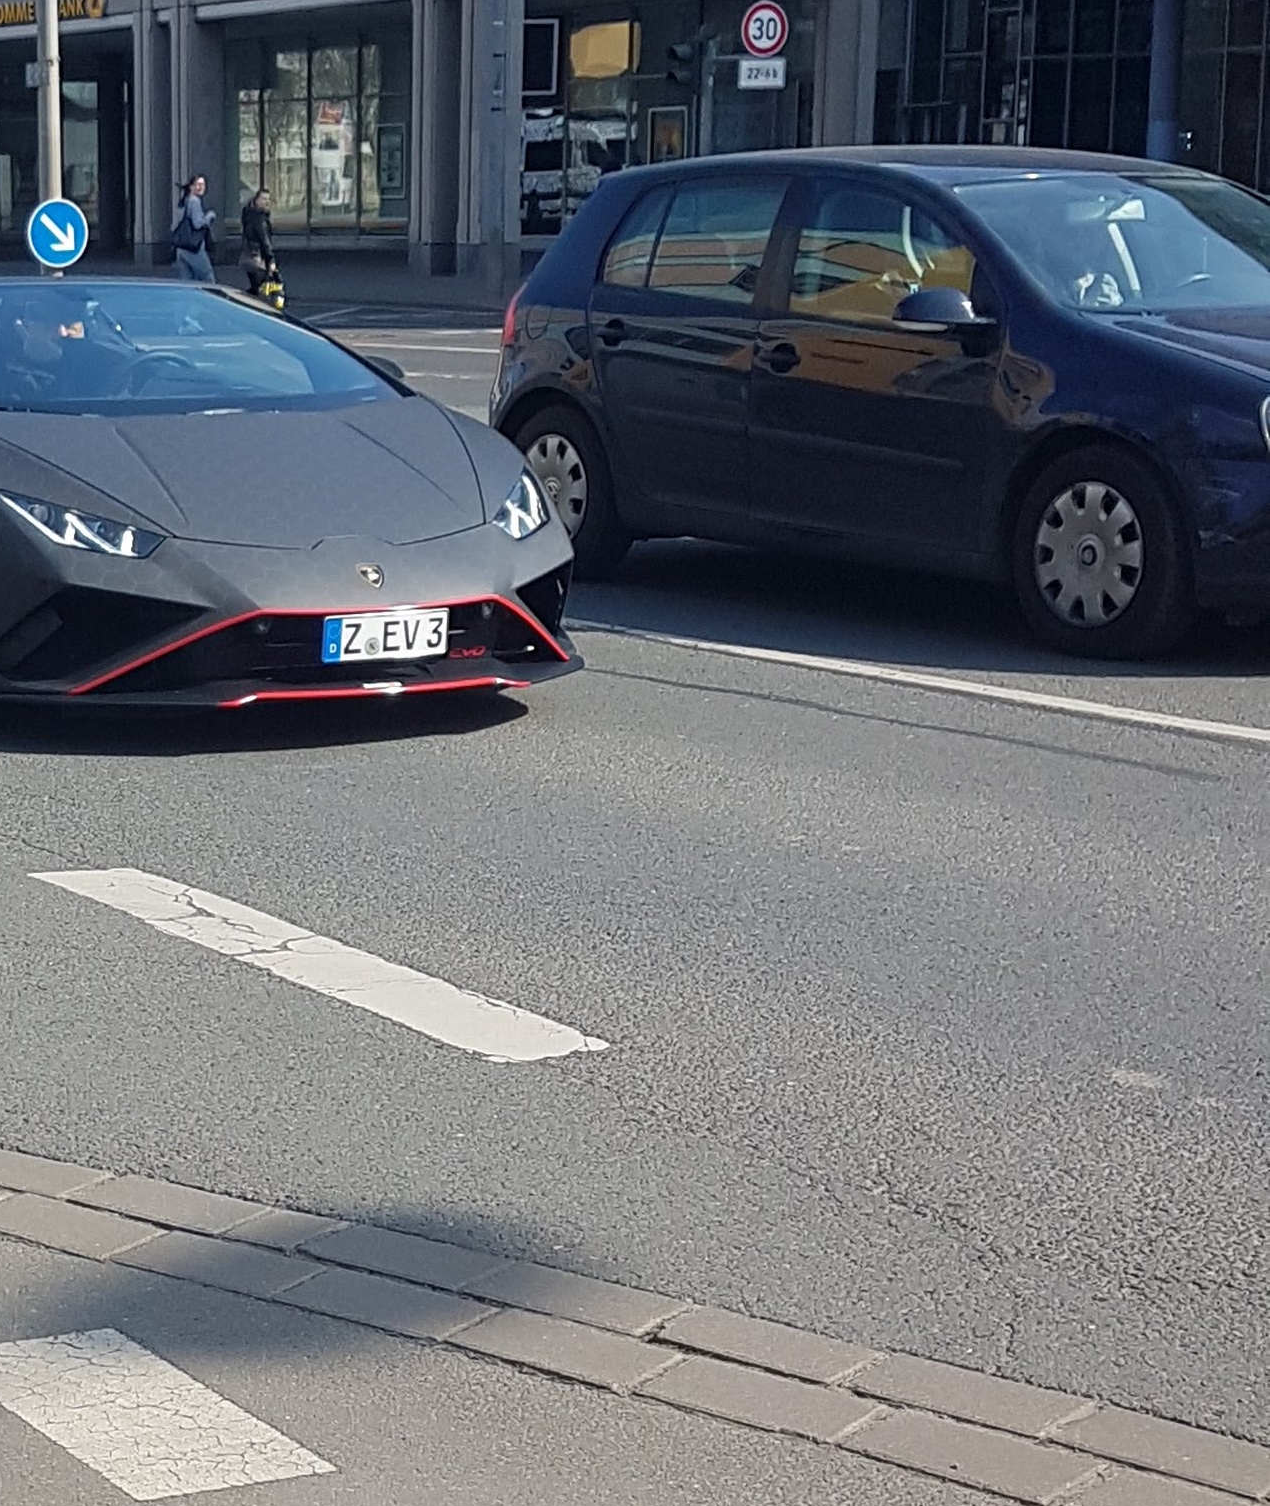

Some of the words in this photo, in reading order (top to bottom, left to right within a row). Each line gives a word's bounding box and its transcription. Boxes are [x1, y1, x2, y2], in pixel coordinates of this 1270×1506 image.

[752, 17, 778, 41] 30
[343, 623, 362, 655] Z
[382, 619, 421, 652] EV
[426, 617, 444, 649] 3
